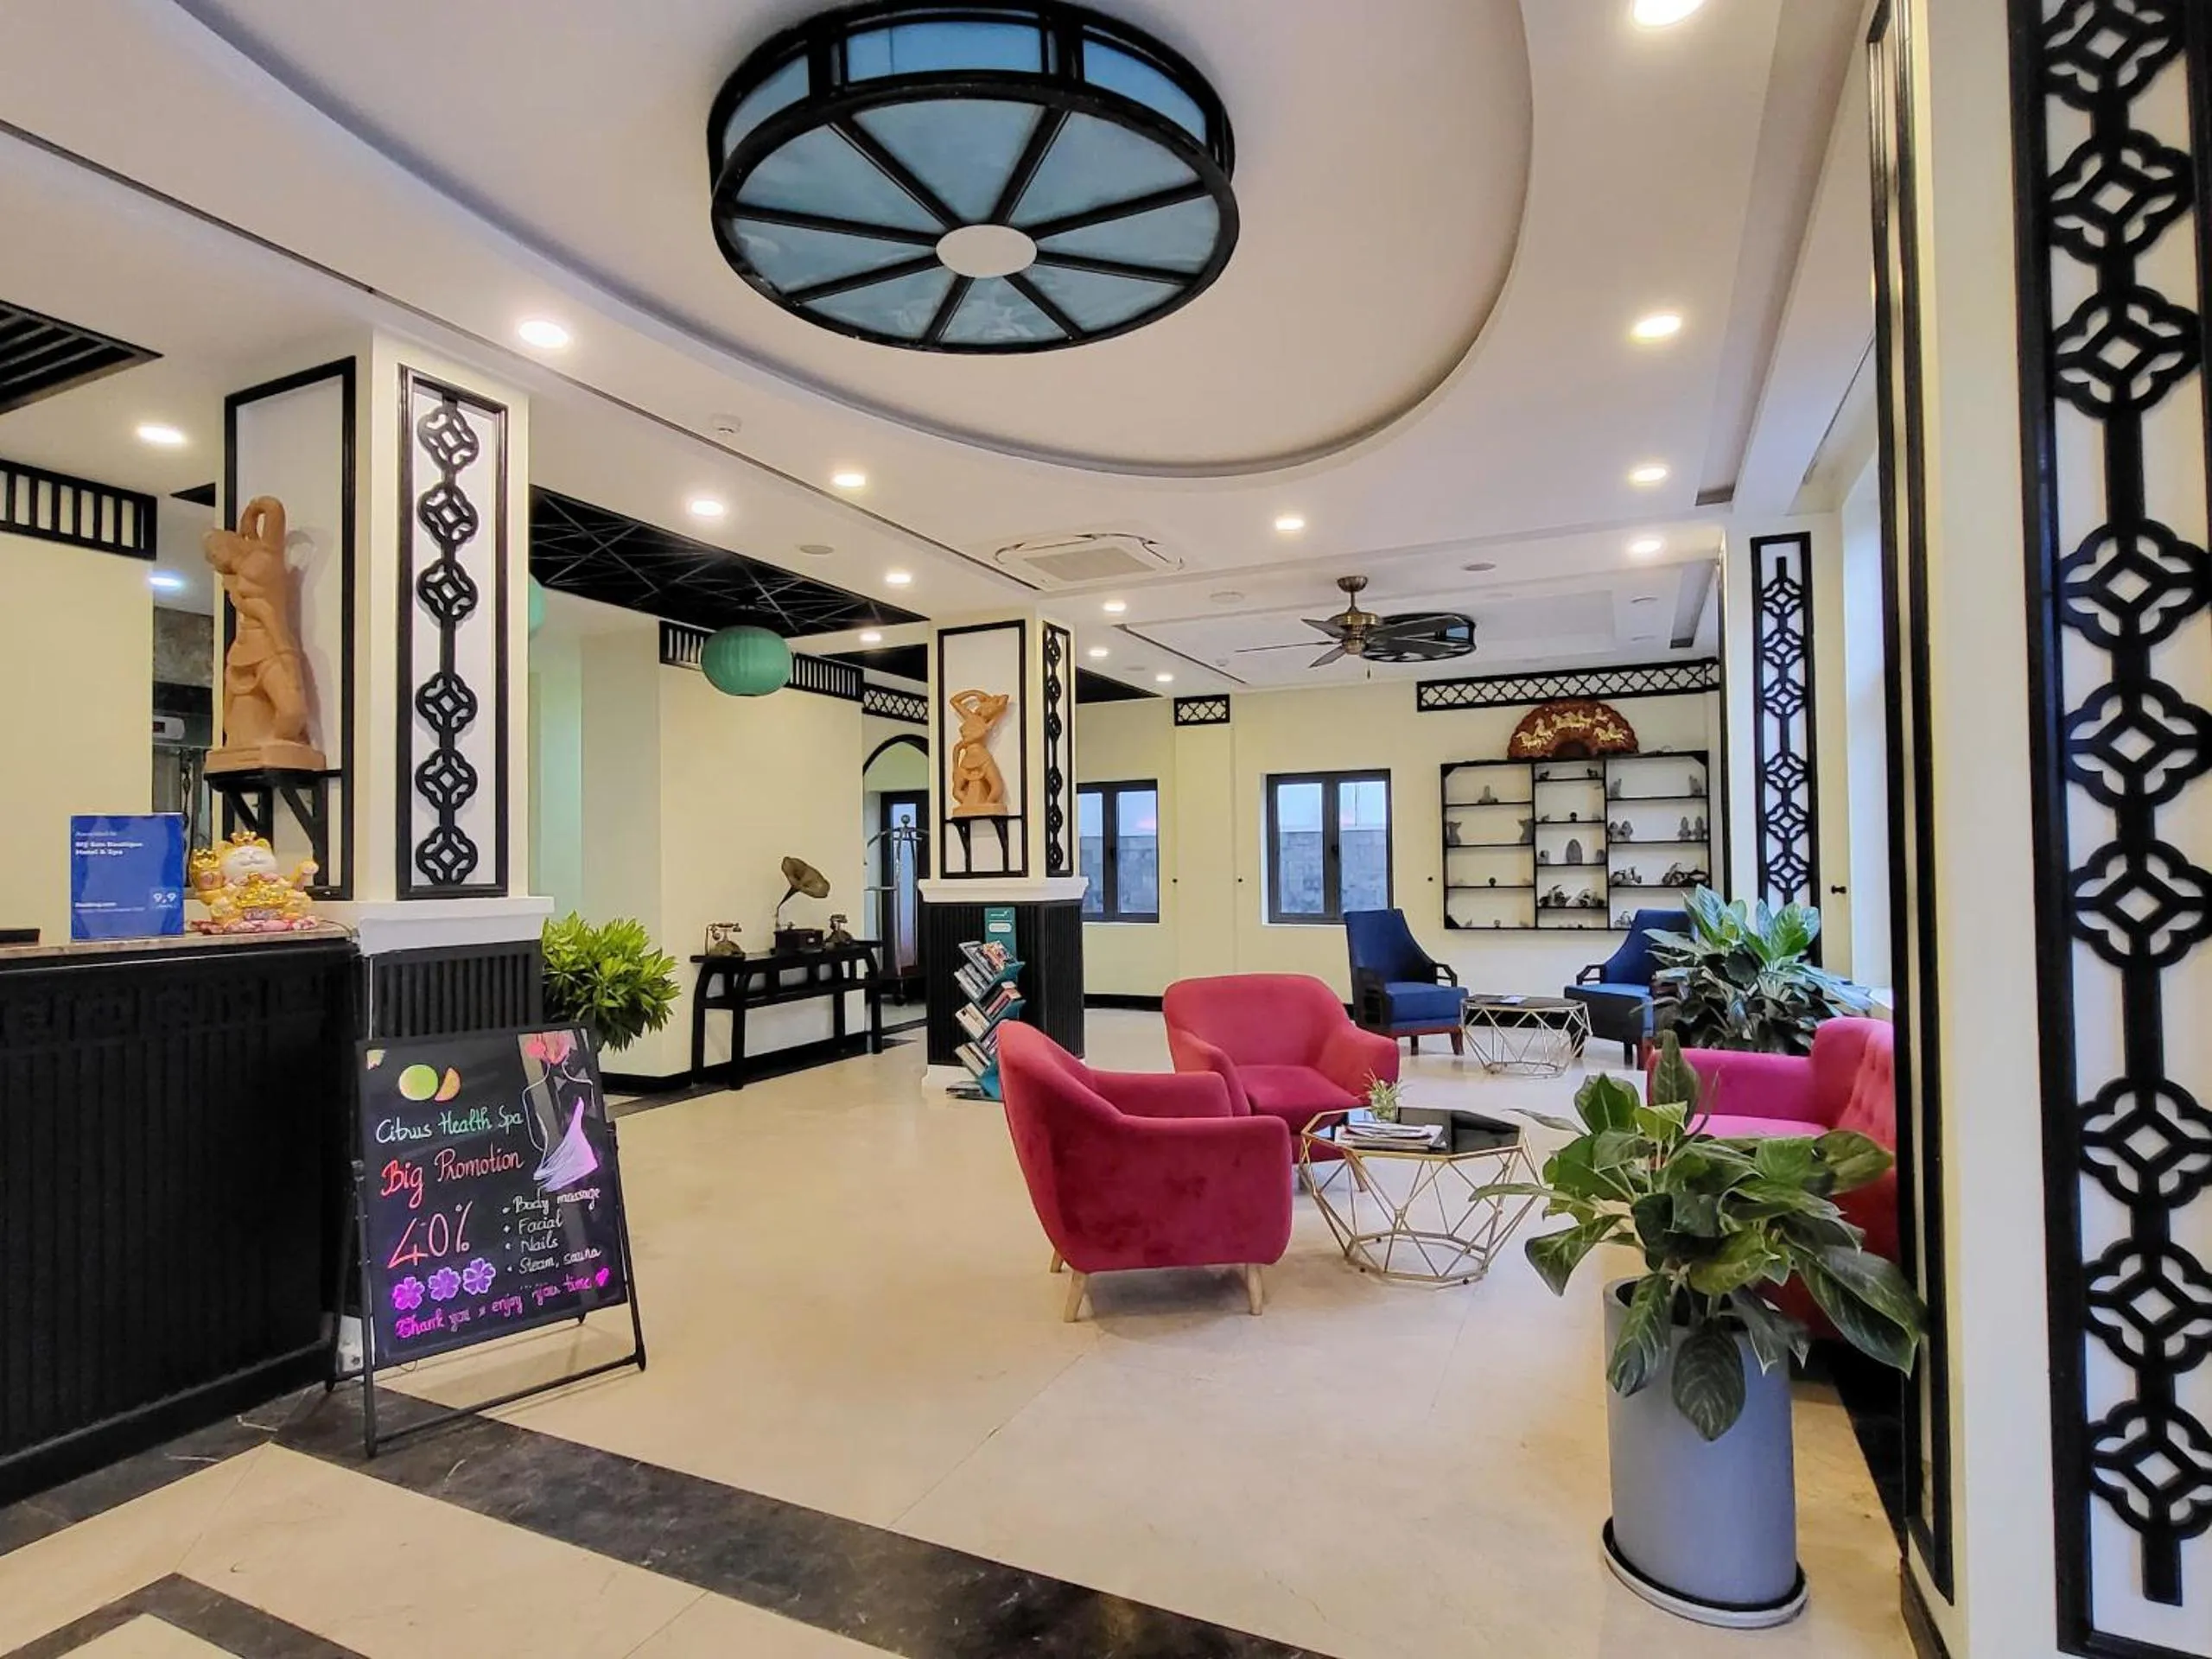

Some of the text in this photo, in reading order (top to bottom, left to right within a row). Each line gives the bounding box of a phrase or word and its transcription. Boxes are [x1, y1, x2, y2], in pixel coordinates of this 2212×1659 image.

[375, 1104, 524, 1144] Citrus Health Spa
[380, 1141, 525, 1209] Big Promotion
[513, 1186, 549, 1215] Body
[387, 1200, 473, 1268] 40%
[518, 1208, 564, 1235] Facial
[521, 1230, 559, 1253] Nails
[563, 1247, 602, 1265] sauna
[396, 1307, 444, 1338] Thank
[448, 1309, 471, 1332] you
[492, 1294, 523, 1317] enjoy
